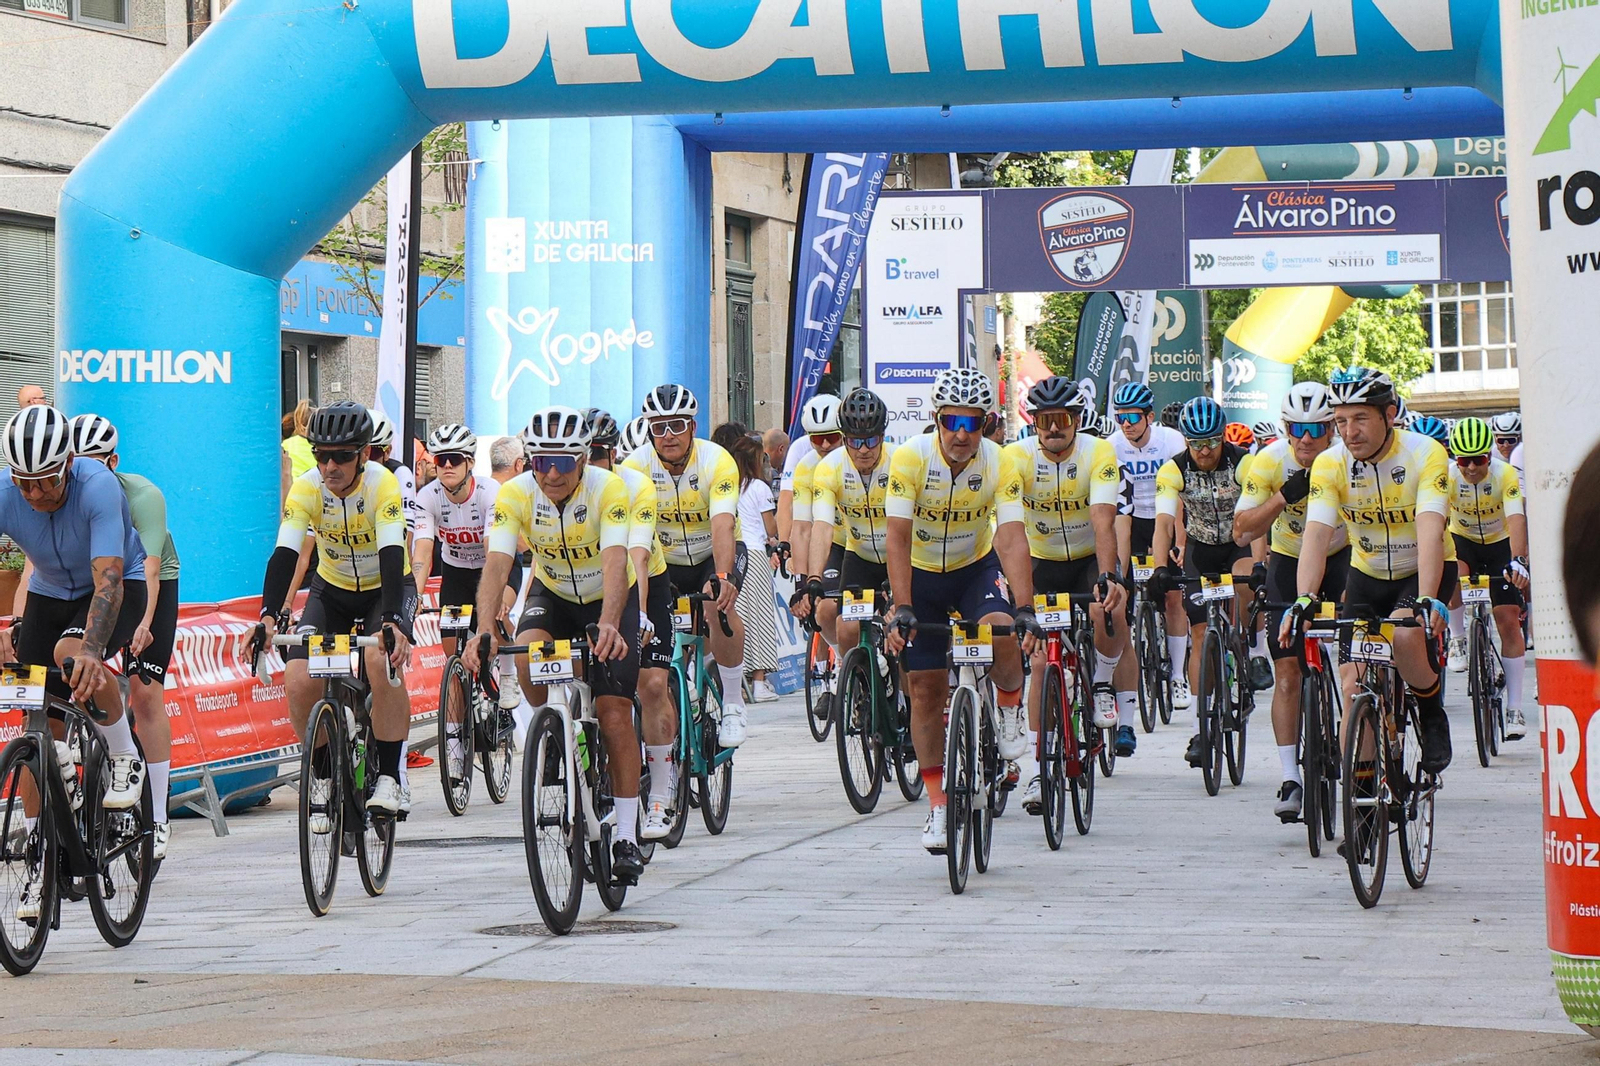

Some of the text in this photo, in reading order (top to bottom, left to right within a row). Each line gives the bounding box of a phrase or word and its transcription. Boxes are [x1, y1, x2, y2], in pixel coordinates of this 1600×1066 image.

[1521, 0, 1599, 19] INGE
[1266, 190, 1326, 207] Clásica
[1537, 170, 1600, 231] ro
[533, 219, 609, 241] XUNTA
[533, 242, 655, 263] DE GALICIA
[1217, 254, 1256, 263] Deputación
[1217, 260, 1256, 268] Pontevedra
[903, 268, 939, 280] travel
[834, 272, 851, 305] como
[316, 286, 382, 318] PONTEA
[1088, 304, 1112, 374] Deputación
[1093, 310, 1118, 378] Pontevedra
[59, 349, 232, 384] DECATHLON
[1222, 400, 1269, 411] ontevedra
[1038, 490, 1074, 498] GRUPO
[926, 498, 970, 507] GRUPO
[1357, 497, 1400, 506] GRUPO
[539, 535, 584, 544] GRUPO
[1373, 541, 1419, 551] PONTEAREA
[557, 568, 604, 580] PONTEAREA
[1134, 568, 1151, 577] 178
[1210, 587, 1226, 595] 35
[1467, 589, 1484, 598] 417
[849, 603, 866, 614] 83
[1044, 612, 1061, 623] 23
[965, 645, 980, 658] 18
[1359, 642, 1385, 655] 102
[539, 661, 562, 675] 40
[16, 686, 27, 699] 2
[194, 689, 239, 714] #froizdeporte
[1544, 830, 1600, 869] #froiz
